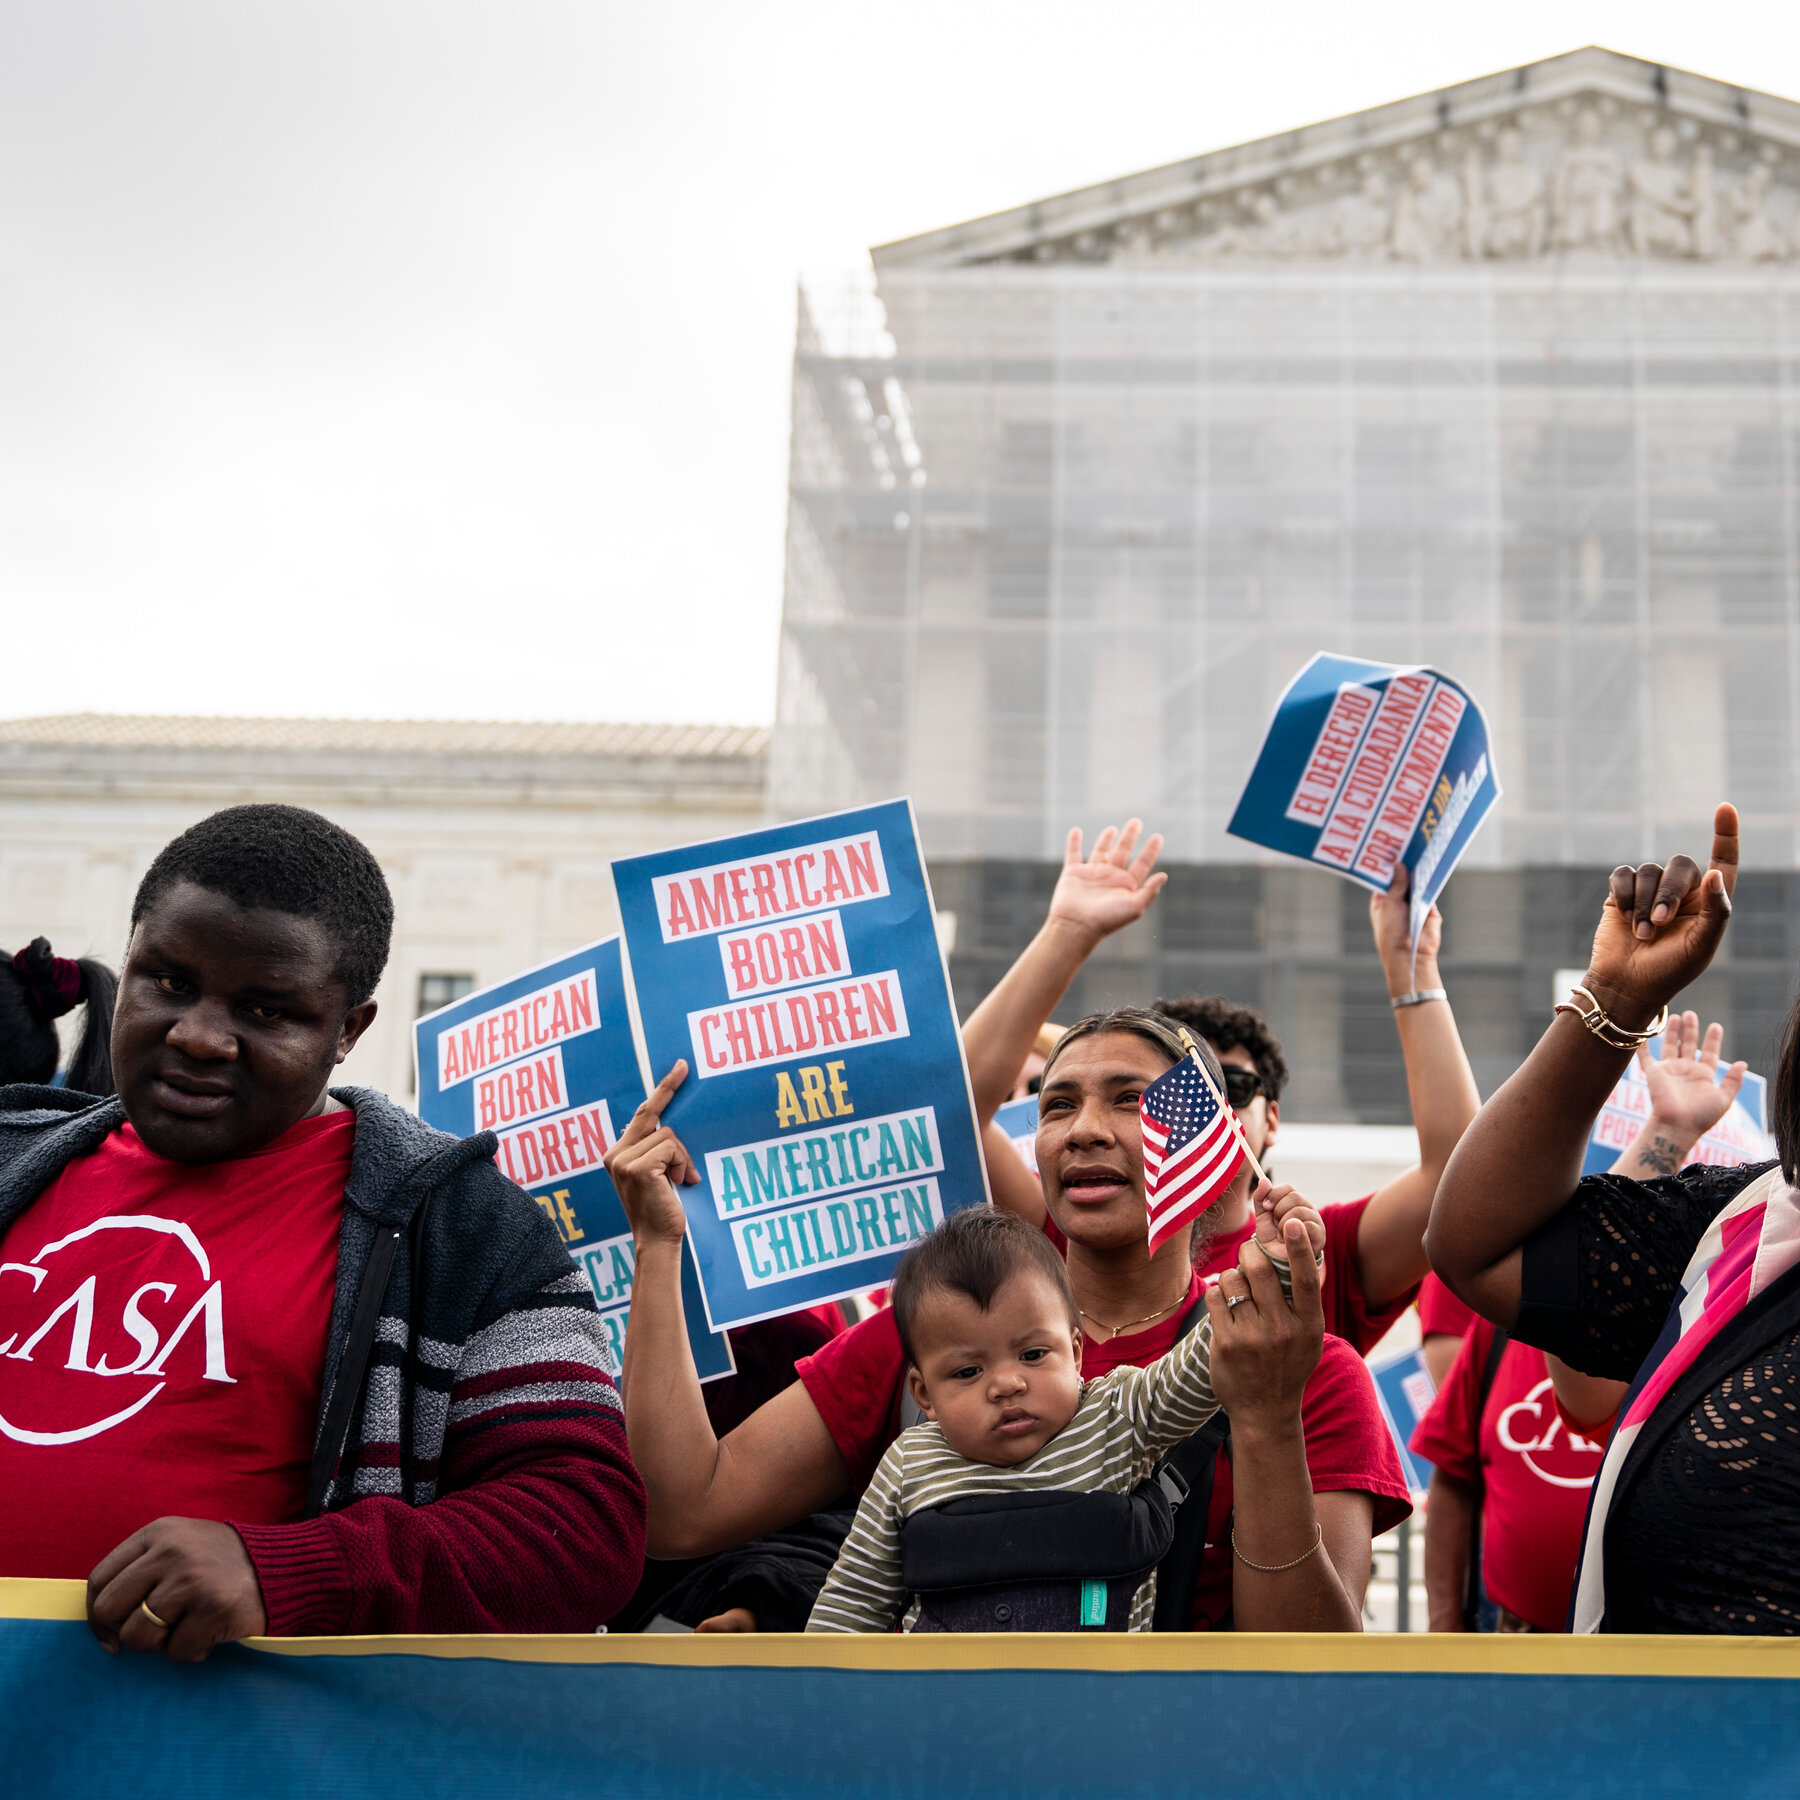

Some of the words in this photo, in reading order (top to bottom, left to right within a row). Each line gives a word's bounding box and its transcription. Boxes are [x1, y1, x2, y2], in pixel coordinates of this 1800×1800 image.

[1306, 692, 1372, 789] DERECHO
[1294, 793, 1329, 816] EL
[1360, 829, 1404, 876] POR
[1382, 691, 1461, 832] NACIMIENTO
[1320, 845, 1352, 862] A
[1328, 814, 1366, 842] LA
[668, 841, 879, 936] AMERICAN
[728, 920, 841, 992] BORN
[444, 979, 592, 1083] AMERICAN
[700, 980, 896, 1069] CHILDREN
[480, 1056, 560, 1130] BORN
[777, 1061, 853, 1127] ARE
[1624, 1085, 1646, 1115] LA
[721, 1116, 933, 1212] AMERICAN
[742, 1185, 933, 1278] CHILDREN
